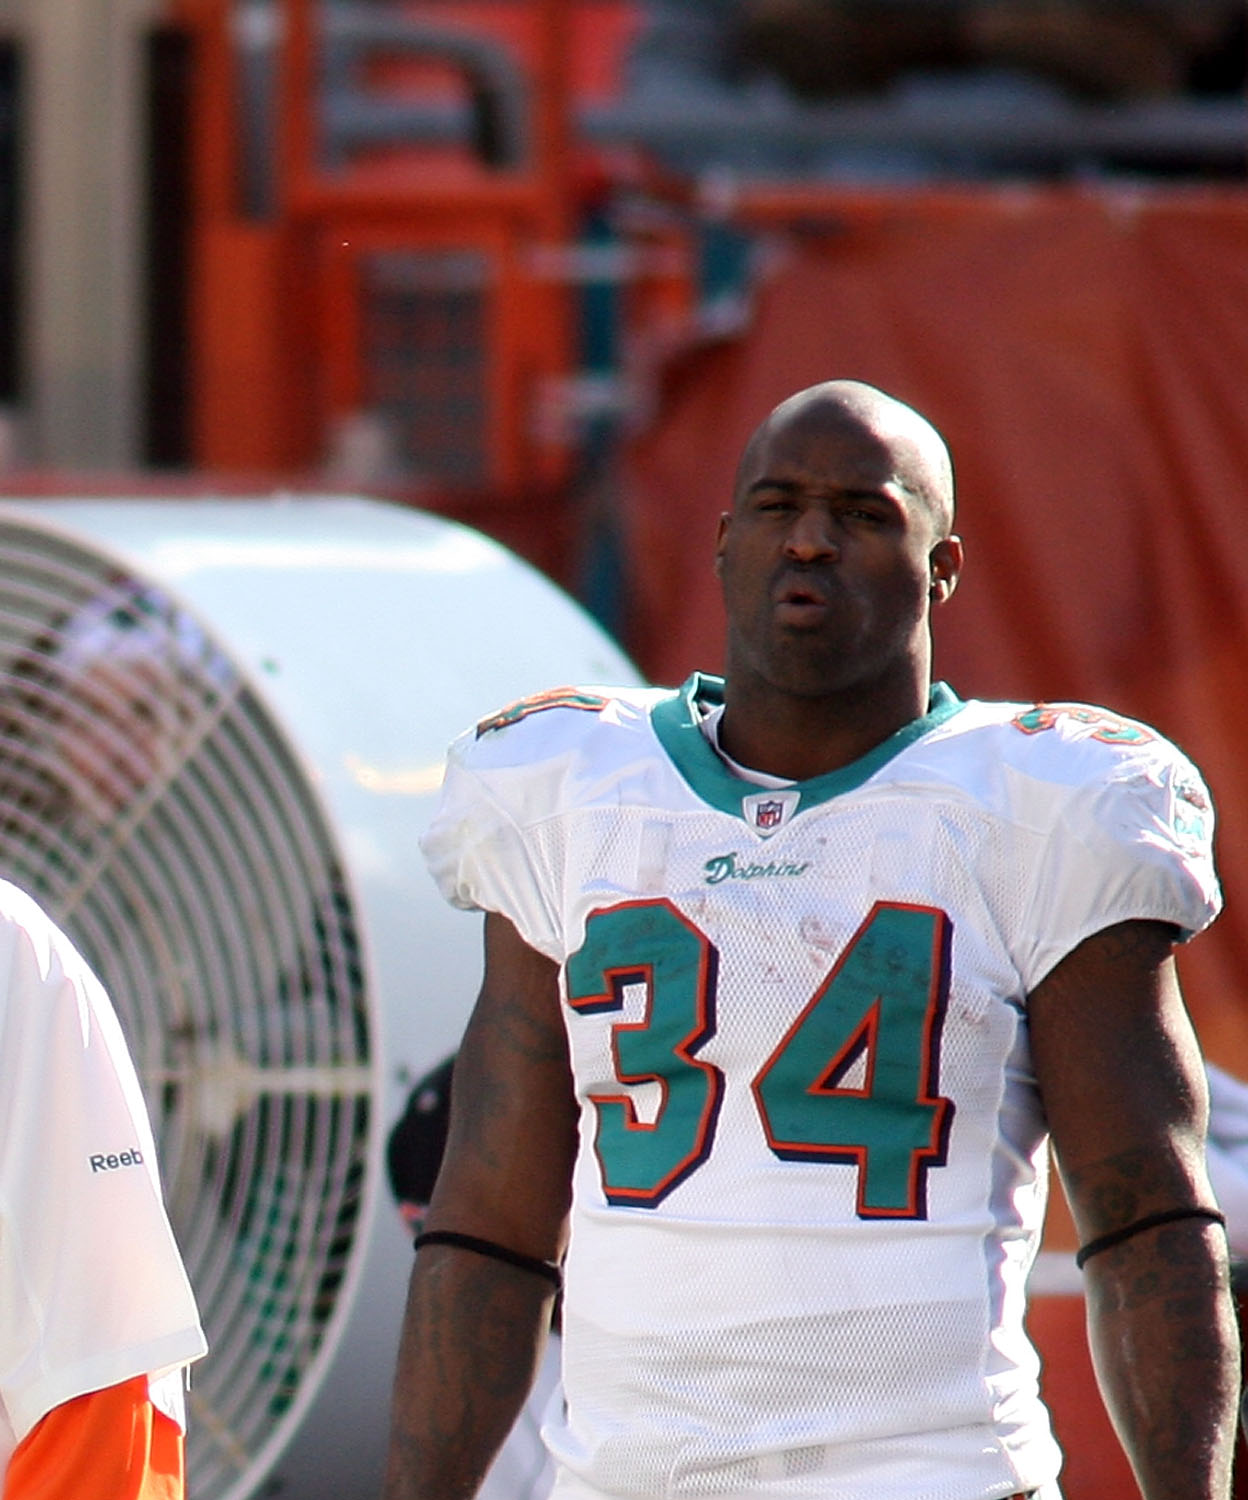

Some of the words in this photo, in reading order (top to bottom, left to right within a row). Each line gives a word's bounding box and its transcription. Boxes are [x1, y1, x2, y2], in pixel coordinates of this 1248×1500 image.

[705, 851, 809, 885] Dolphins
[566, 897, 956, 1221] 34
[89, 1147, 144, 1173] Reeb
